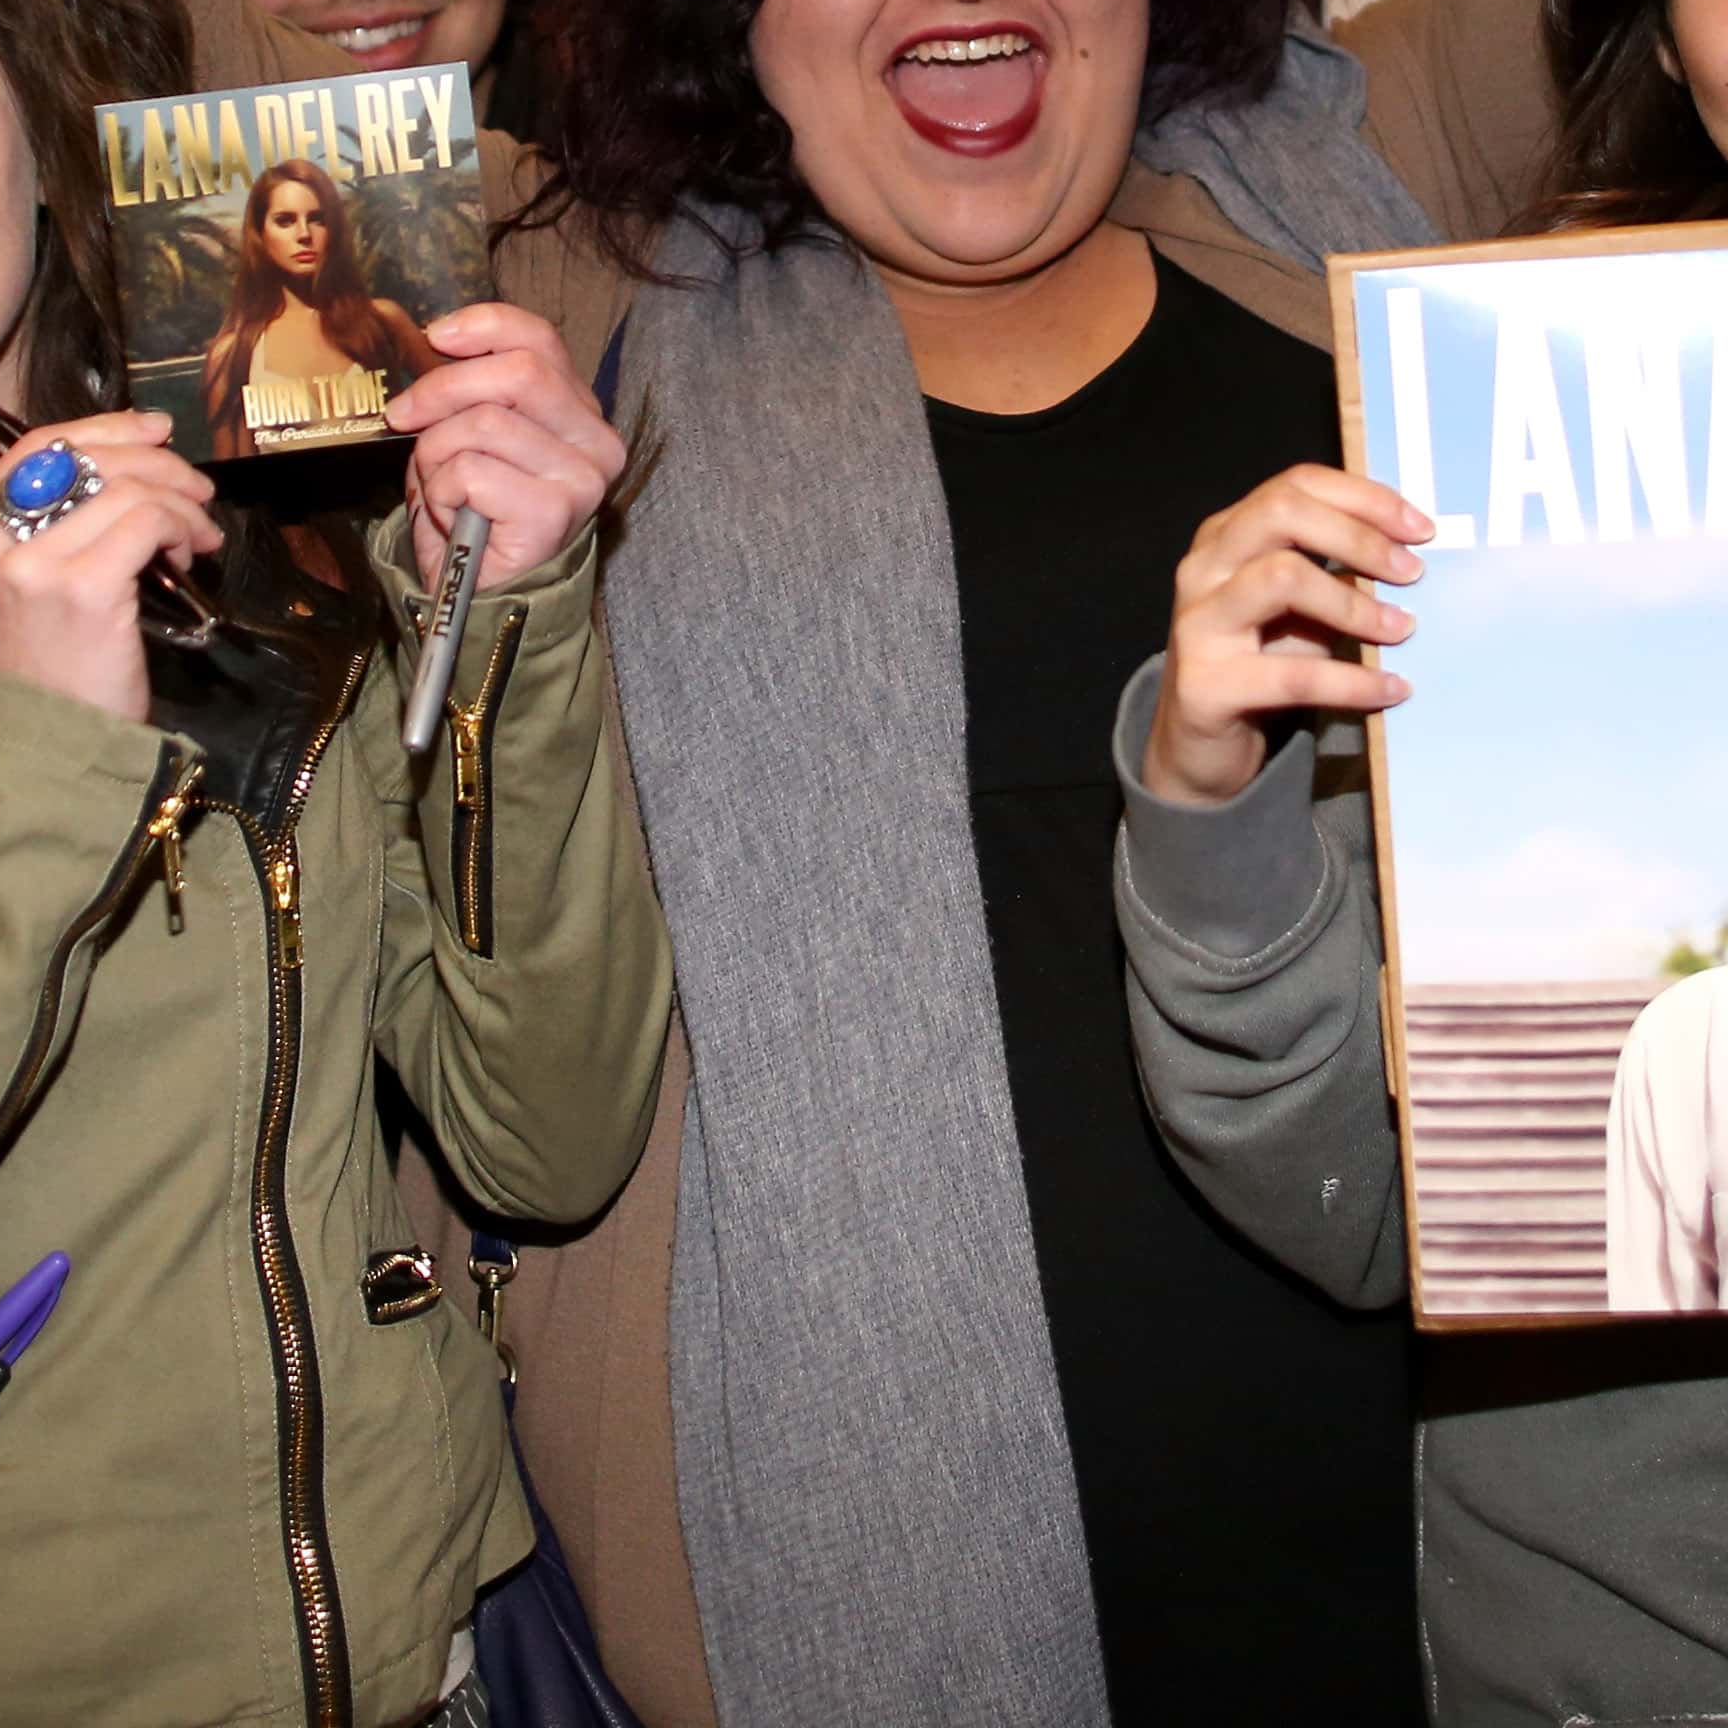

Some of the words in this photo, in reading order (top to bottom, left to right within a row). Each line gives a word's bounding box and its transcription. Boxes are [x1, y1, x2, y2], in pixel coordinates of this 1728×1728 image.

[104, 99, 254, 207] LANA
[254, 89, 354, 180] DEL
[354, 74, 454, 177] REY
[242, 376, 310, 429] BORN
[313, 373, 349, 420] TO
[353, 369, 387, 416] DIE
